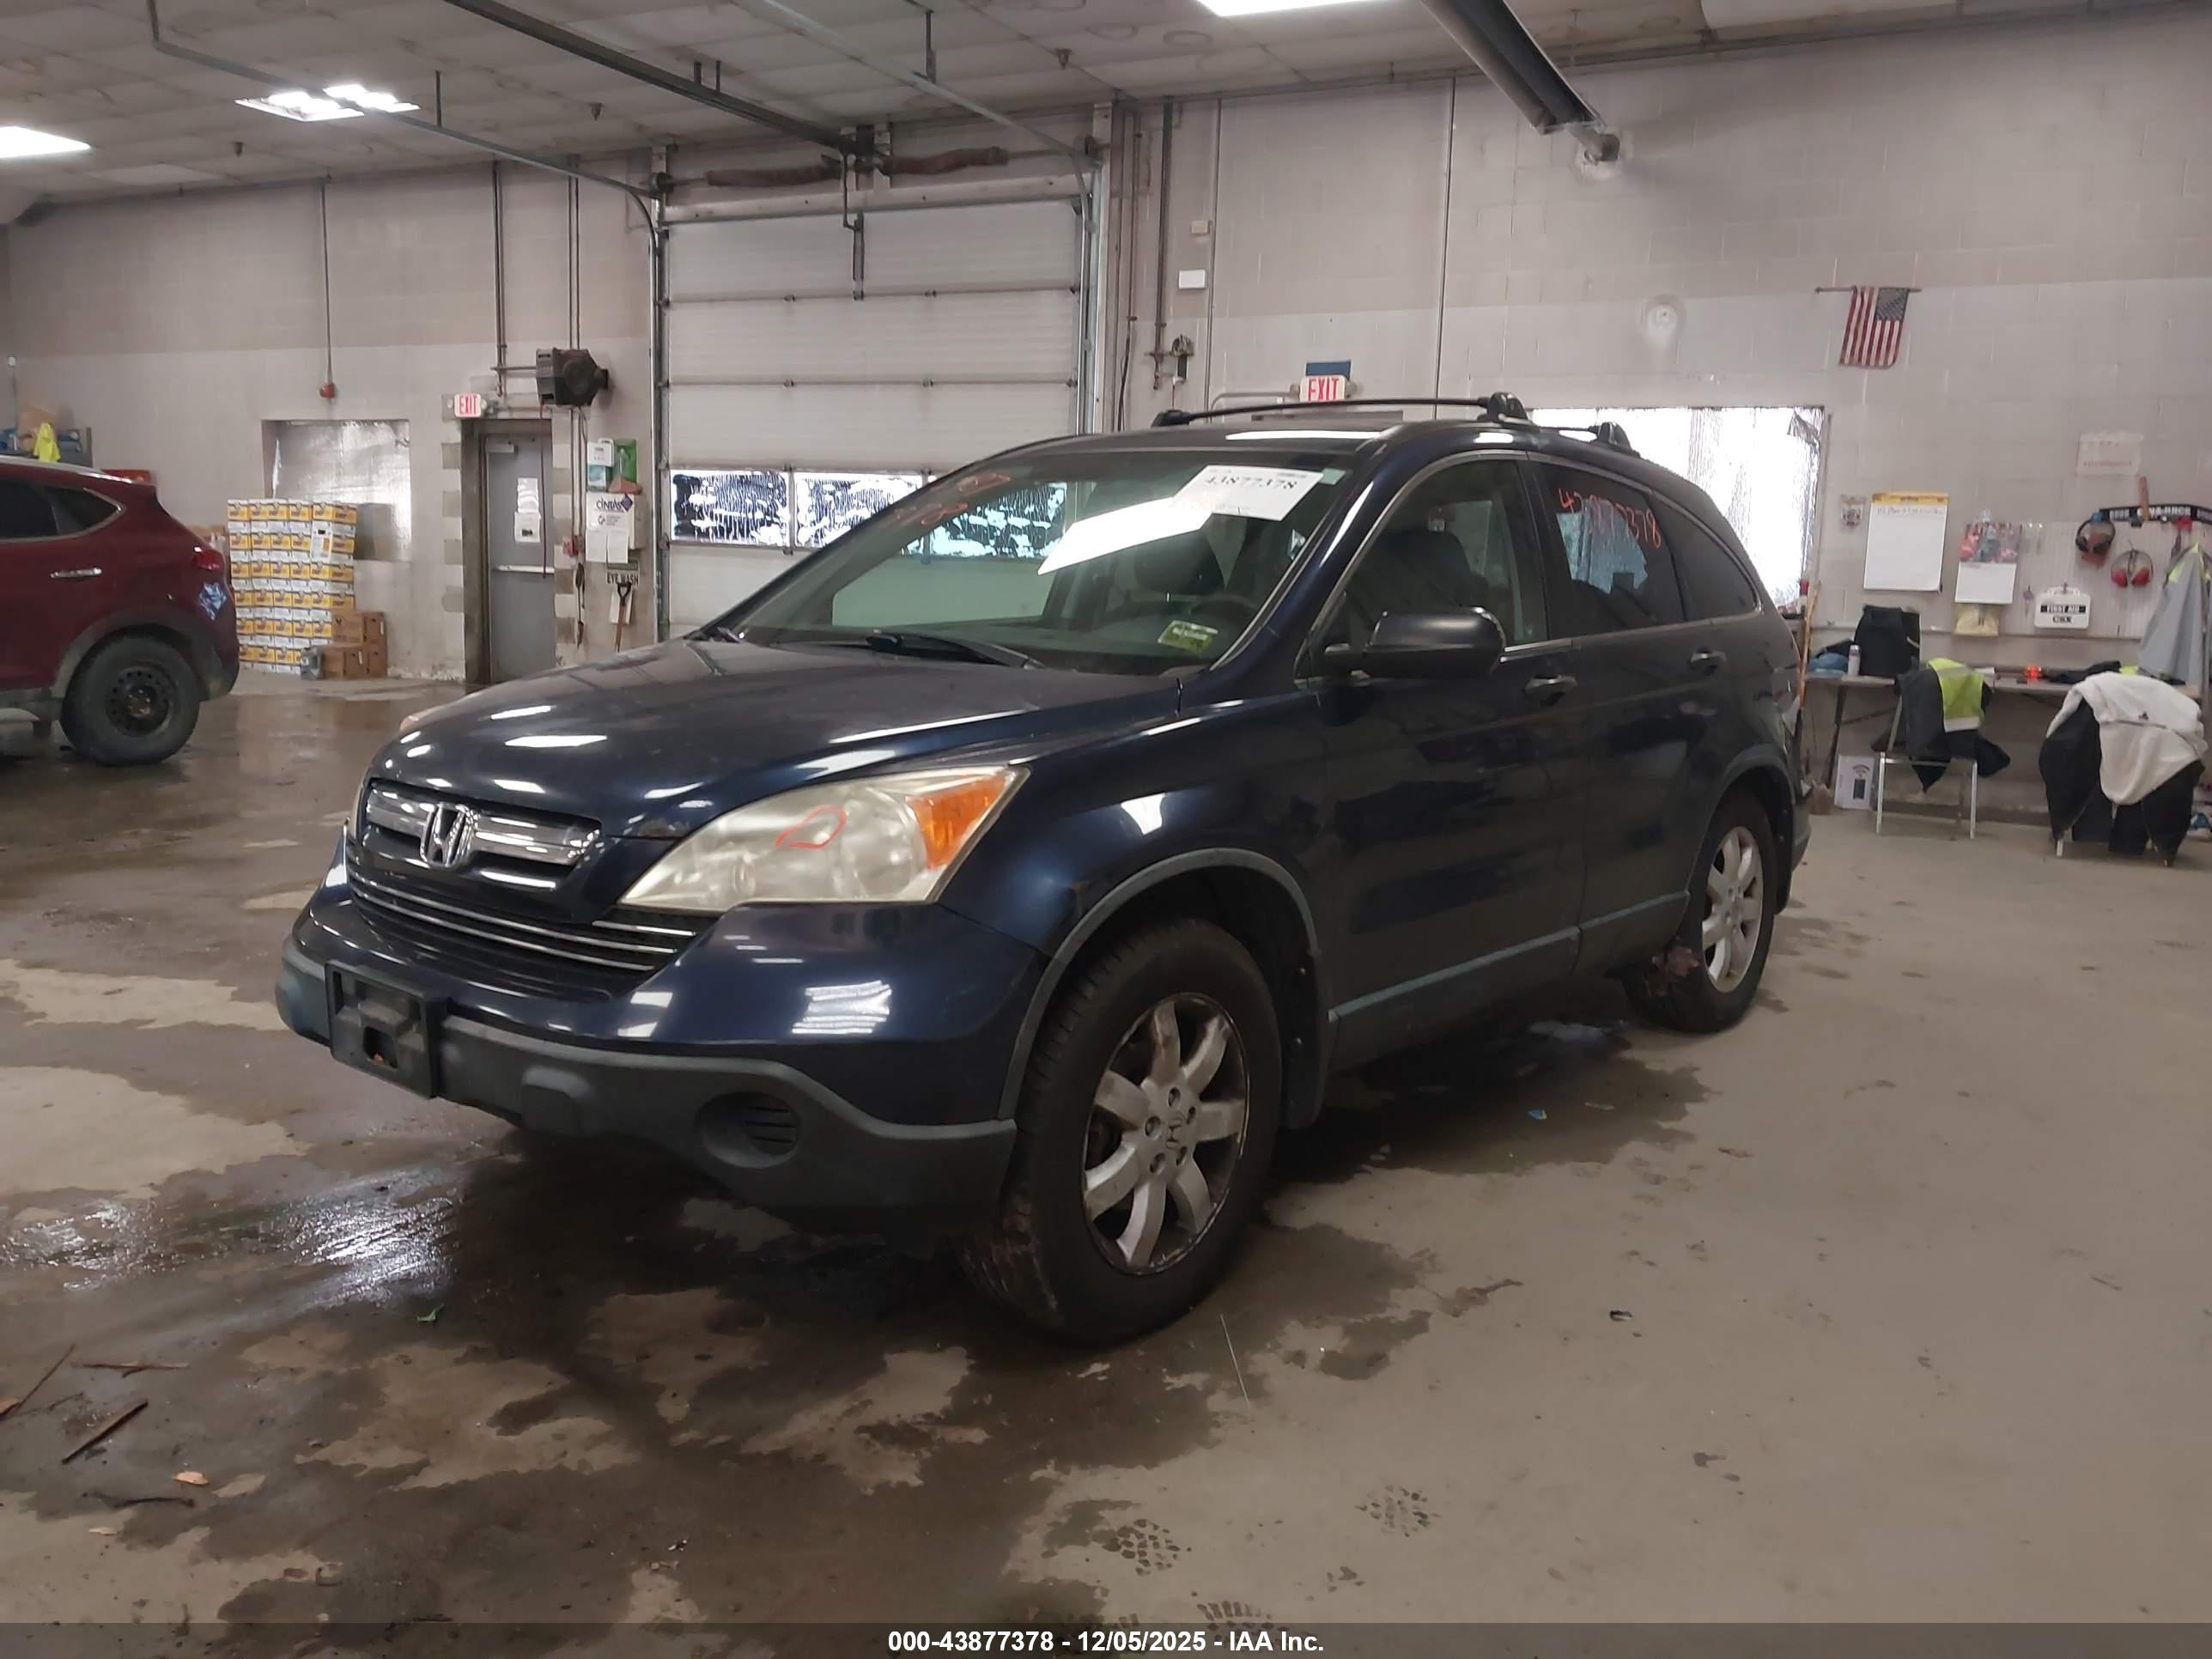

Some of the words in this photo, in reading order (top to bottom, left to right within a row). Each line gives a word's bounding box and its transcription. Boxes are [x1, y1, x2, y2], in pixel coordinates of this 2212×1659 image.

[1308, 377, 1340, 401] EXIT
[459, 394, 477, 414] EXIT
[596, 497, 622, 510] CINTAS
